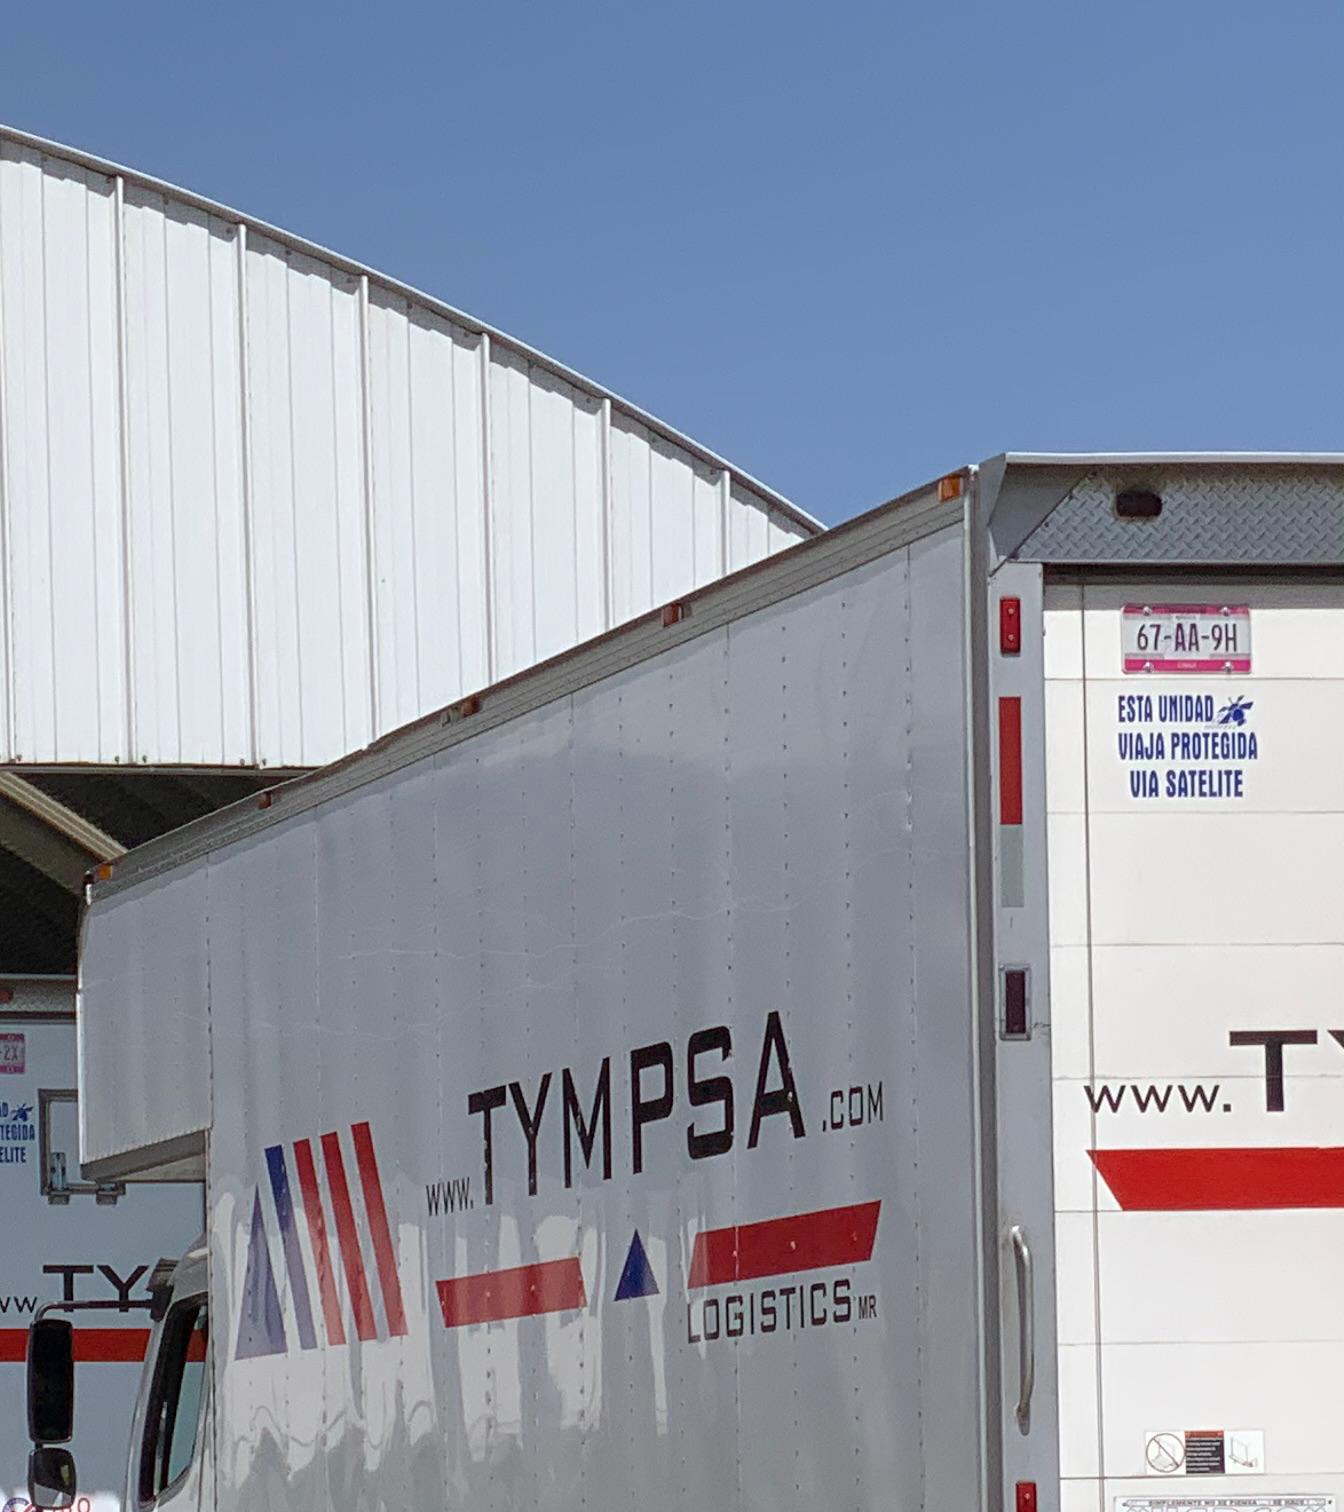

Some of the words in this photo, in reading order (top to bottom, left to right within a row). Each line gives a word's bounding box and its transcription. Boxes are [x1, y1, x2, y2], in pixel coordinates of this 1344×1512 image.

[1136, 622, 1238, 653] 67-AA-9H
[1118, 695, 1154, 723] ESTA
[1158, 695, 1214, 723] UNIDAD
[1118, 732, 1165, 760] VIAJA
[1171, 732, 1258, 760] PROTEGIDA
[1130, 770, 1159, 797] VIA
[1166, 770, 1244, 798] SATELITE
[687, 1279, 854, 1344] LOGISTICS
[857, 1294, 878, 1320] MR
